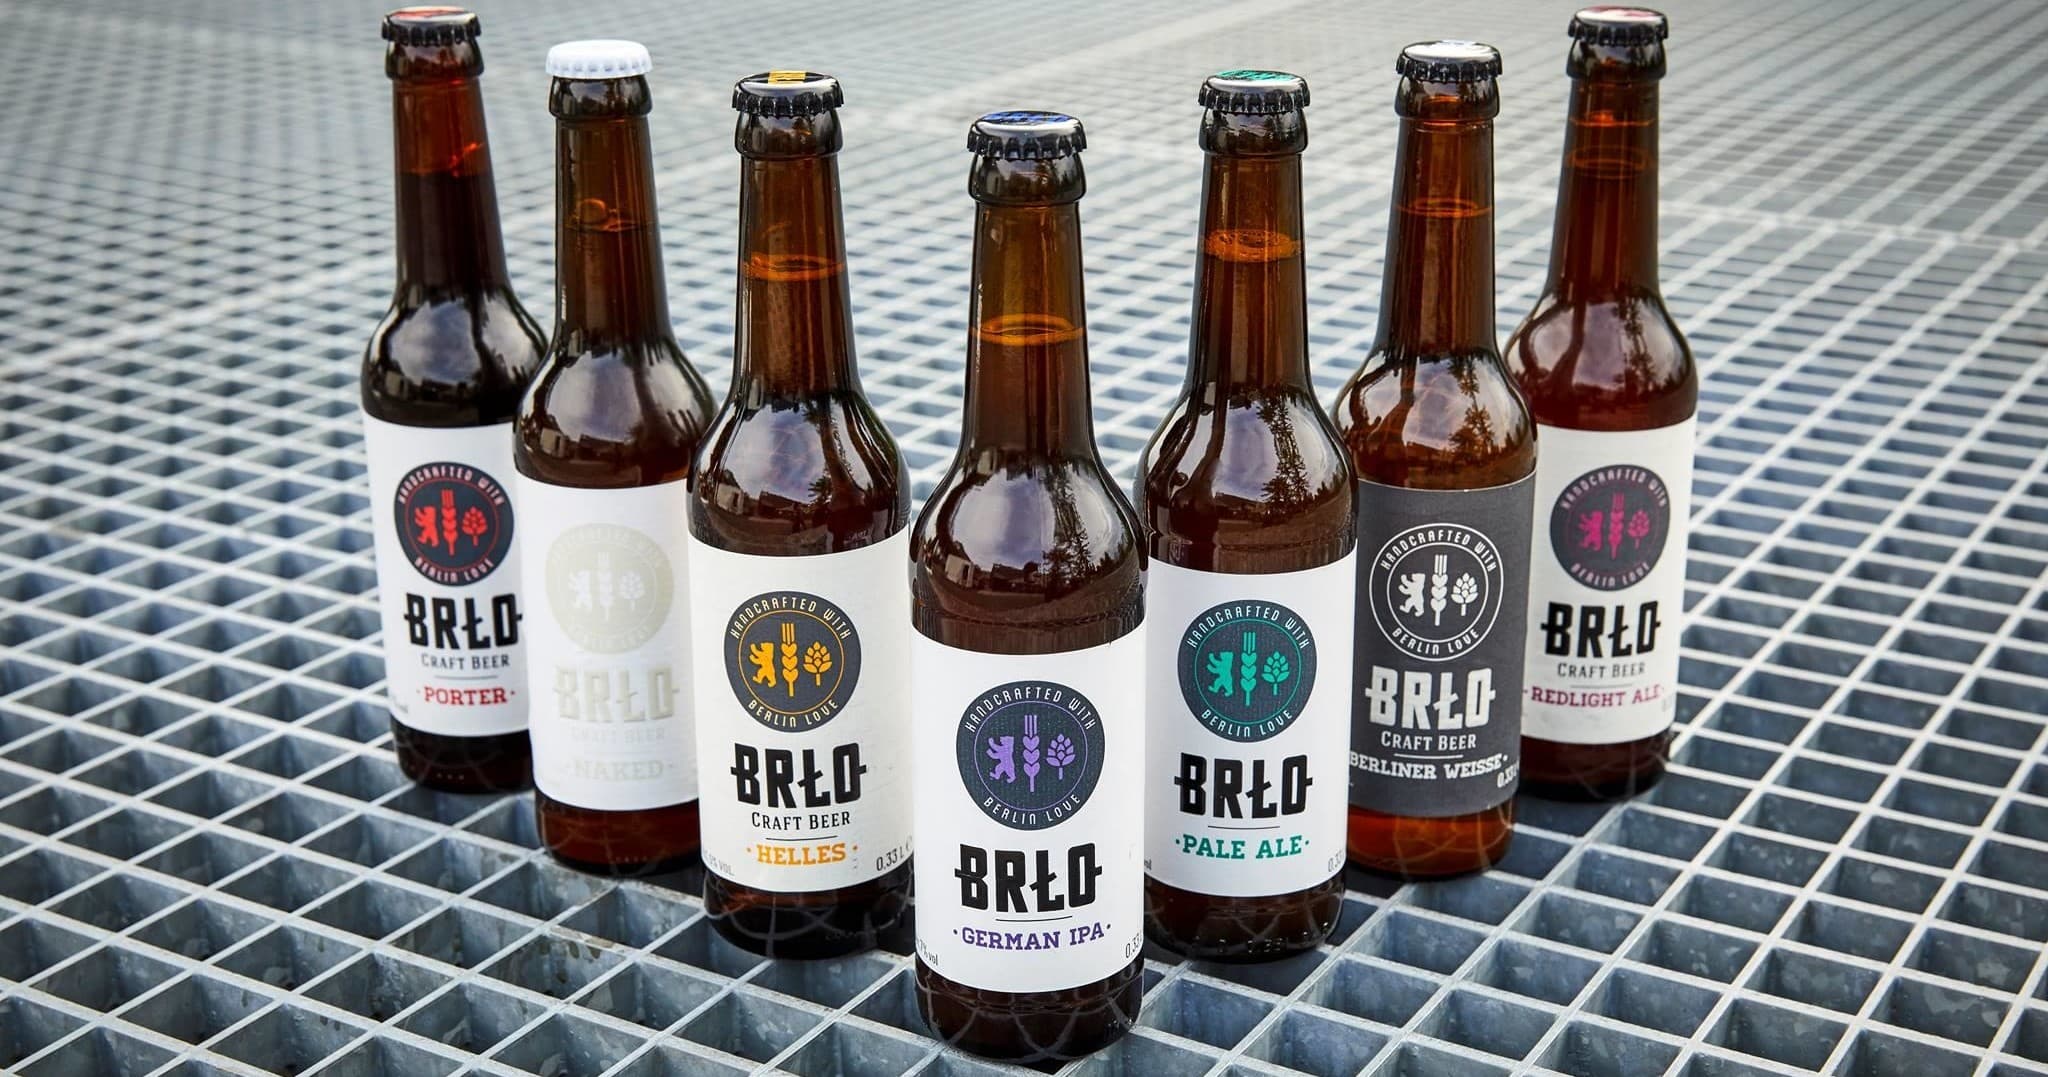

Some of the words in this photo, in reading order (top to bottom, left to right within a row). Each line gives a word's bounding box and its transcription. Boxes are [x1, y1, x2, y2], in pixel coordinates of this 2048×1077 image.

[1380, 529, 1471, 571] HANDCRAFTED
[1474, 541, 1497, 572] WITH
[403, 592, 523, 650] BRŁO
[730, 597, 817, 639] HANDCRAFTED
[823, 608, 851, 639] WITH
[1187, 605, 1280, 648] HANDCRAFTED
[1284, 616, 1310, 649] WITH
[1540, 600, 1662, 658] BRŁO
[1392, 627, 1440, 656] BERLIN
[1448, 628, 1479, 654] LOVE
[421, 653, 465, 670] CRAFT
[471, 654, 511, 670] BEER
[1557, 663, 1606, 679] CRAFT
[1612, 662, 1646, 678] BEER
[424, 686, 507, 705] PORTER
[965, 686, 1062, 732] HANDCRAFTED
[1068, 697, 1097, 730] WITH
[1365, 665, 1497, 730] BRŁO
[1531, 686, 1626, 707] REDLIGHT
[1632, 684, 1660, 705] ALE
[748, 699, 797, 728] BERLIN
[804, 699, 838, 725] LOVE
[1201, 709, 1251, 737] BERLIN
[1260, 708, 1293, 736] LOVE
[1381, 731, 1432, 751] CRAFT
[1438, 733, 1477, 751] BEER
[730, 742, 868, 808] BRŁO
[1350, 750, 1437, 780] BERLINER
[1443, 752, 1502, 780] WEISSE
[1174, 752, 1313, 819] BRŁO
[752, 812, 802, 831] CRAFT
[809, 811, 851, 830] BEER
[984, 796, 1036, 824] BERLIN
[1046, 794, 1081, 822] LOVE
[757, 842, 846, 866] HELLES
[1182, 833, 1246, 860] PALE
[1255, 834, 1303, 859] ALE
[954, 842, 1103, 913] BRŁO
[961, 926, 1061, 951] GERMAN
[1070, 921, 1105, 946] IPA
